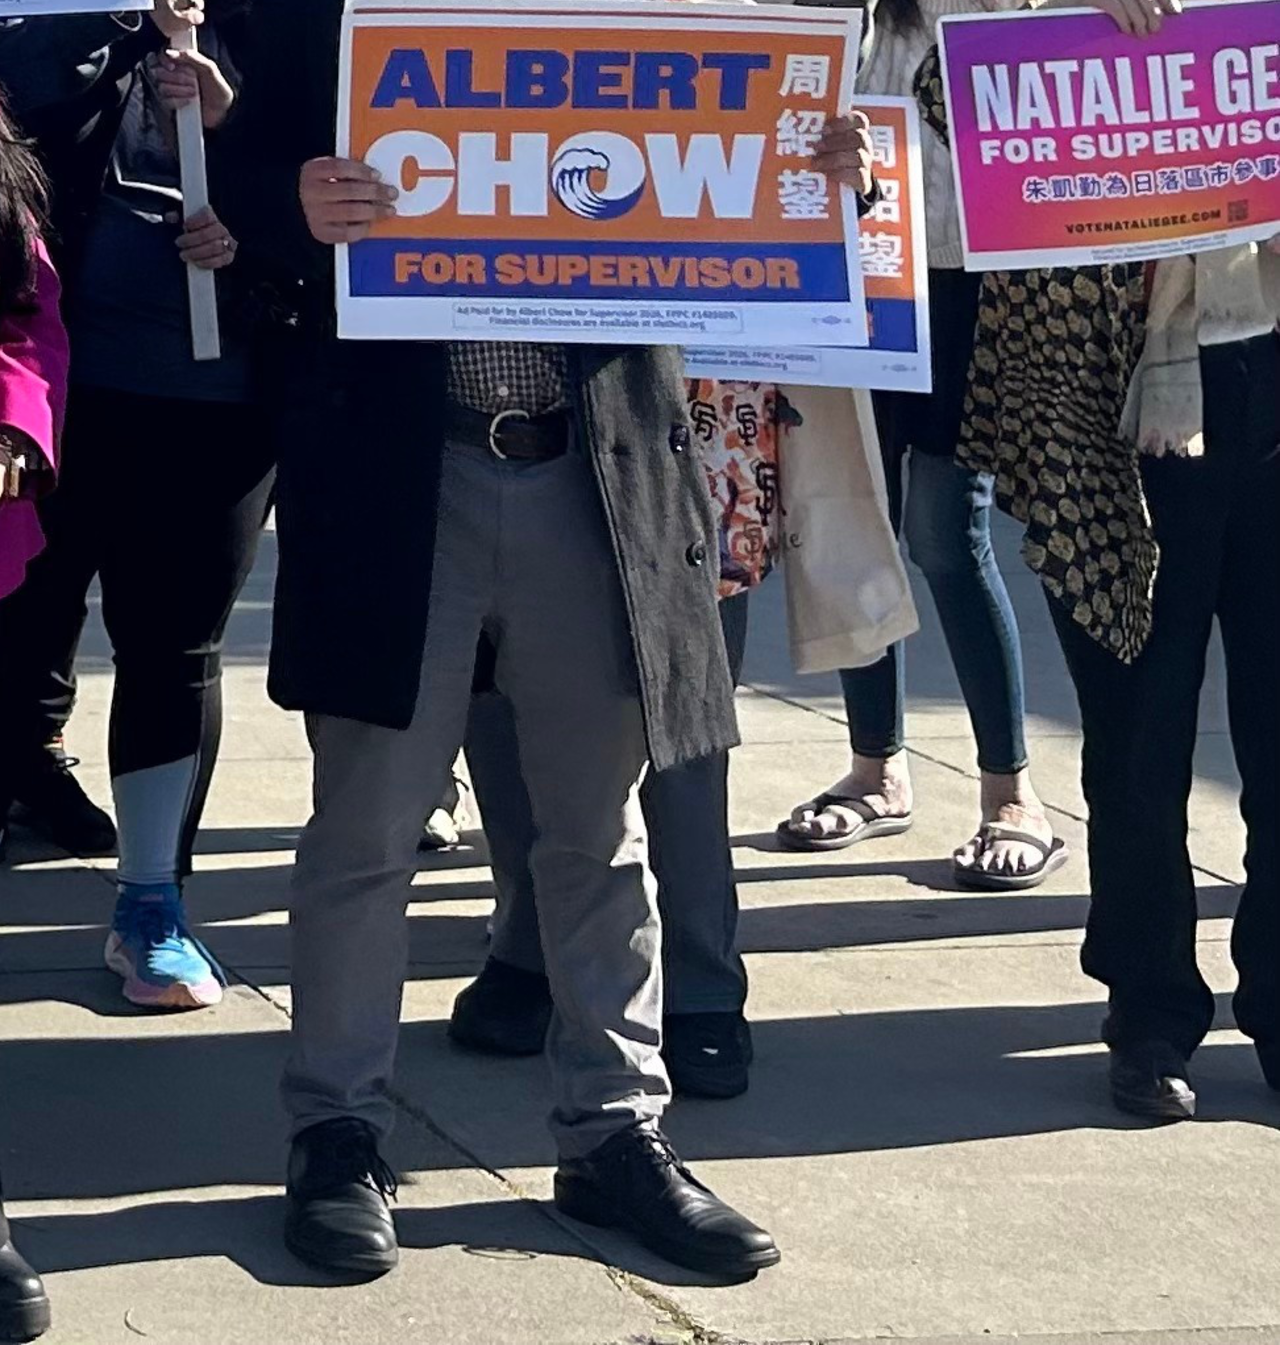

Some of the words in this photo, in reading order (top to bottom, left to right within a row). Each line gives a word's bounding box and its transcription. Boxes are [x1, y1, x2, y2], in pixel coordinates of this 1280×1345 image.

[370, 48, 772, 111] ALBERT
[971, 52, 1201, 133] NATALIE
[364, 129, 767, 220] CHOW
[980, 136, 1058, 166] FOR
[394, 252, 486, 285] FOR
[495, 253, 802, 291] SUPERVISOR
